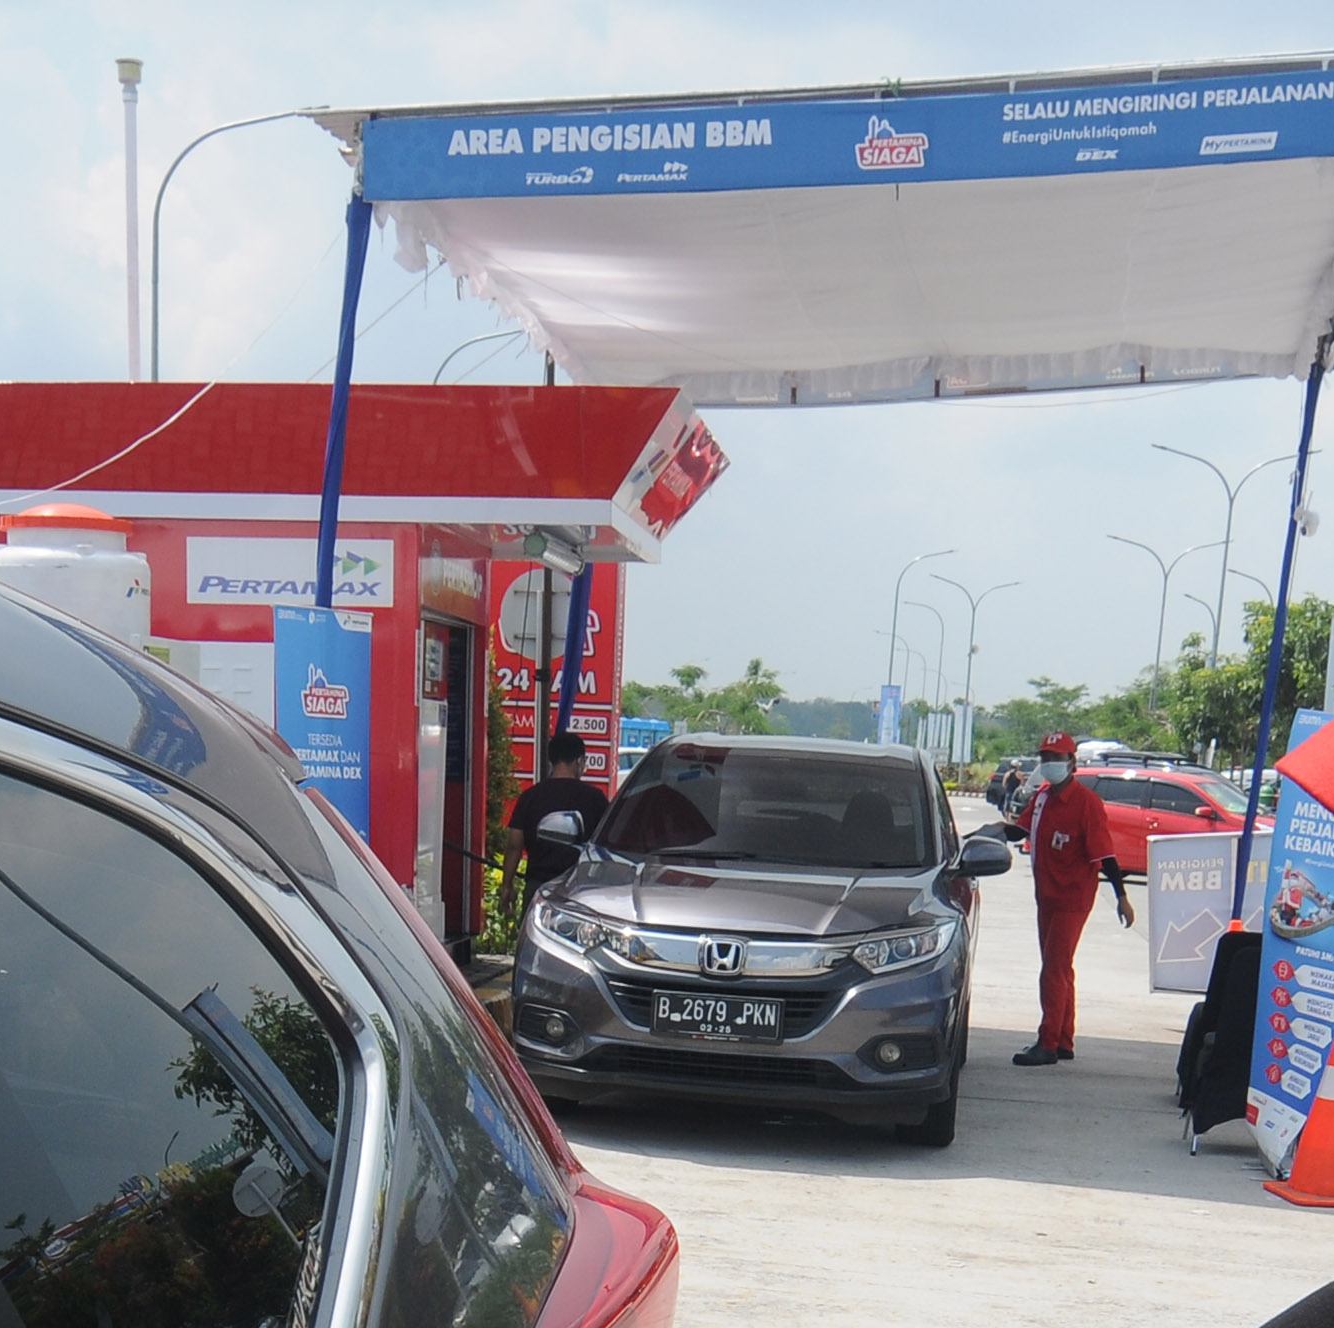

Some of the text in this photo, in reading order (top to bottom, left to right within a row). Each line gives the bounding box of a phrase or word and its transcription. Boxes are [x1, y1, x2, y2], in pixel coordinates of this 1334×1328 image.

[1002, 100, 1070, 121] SELALU
[1073, 91, 1197, 117] MENGIRINGI
[1202, 81, 1334, 108] PERJALANAN
[447, 119, 773, 156] AREA PENGISIAN BBM
[872, 137, 924, 148] PERTAMINA
[1002, 121, 1158, 145] #EnergiUntukIstiqomah
[861, 146, 920, 165] SIAGA
[525, 174, 584, 186] TURBO
[617, 172, 688, 183] PERTAMAX
[496, 667, 530, 692] 24
[306, 695, 344, 714] SIAGA
[308, 733, 343, 747] TERSEDIA
[340, 750, 361, 763] DAN
[343, 766, 362, 780] DEX
[658, 996, 776, 1026] B 2679 PKN
